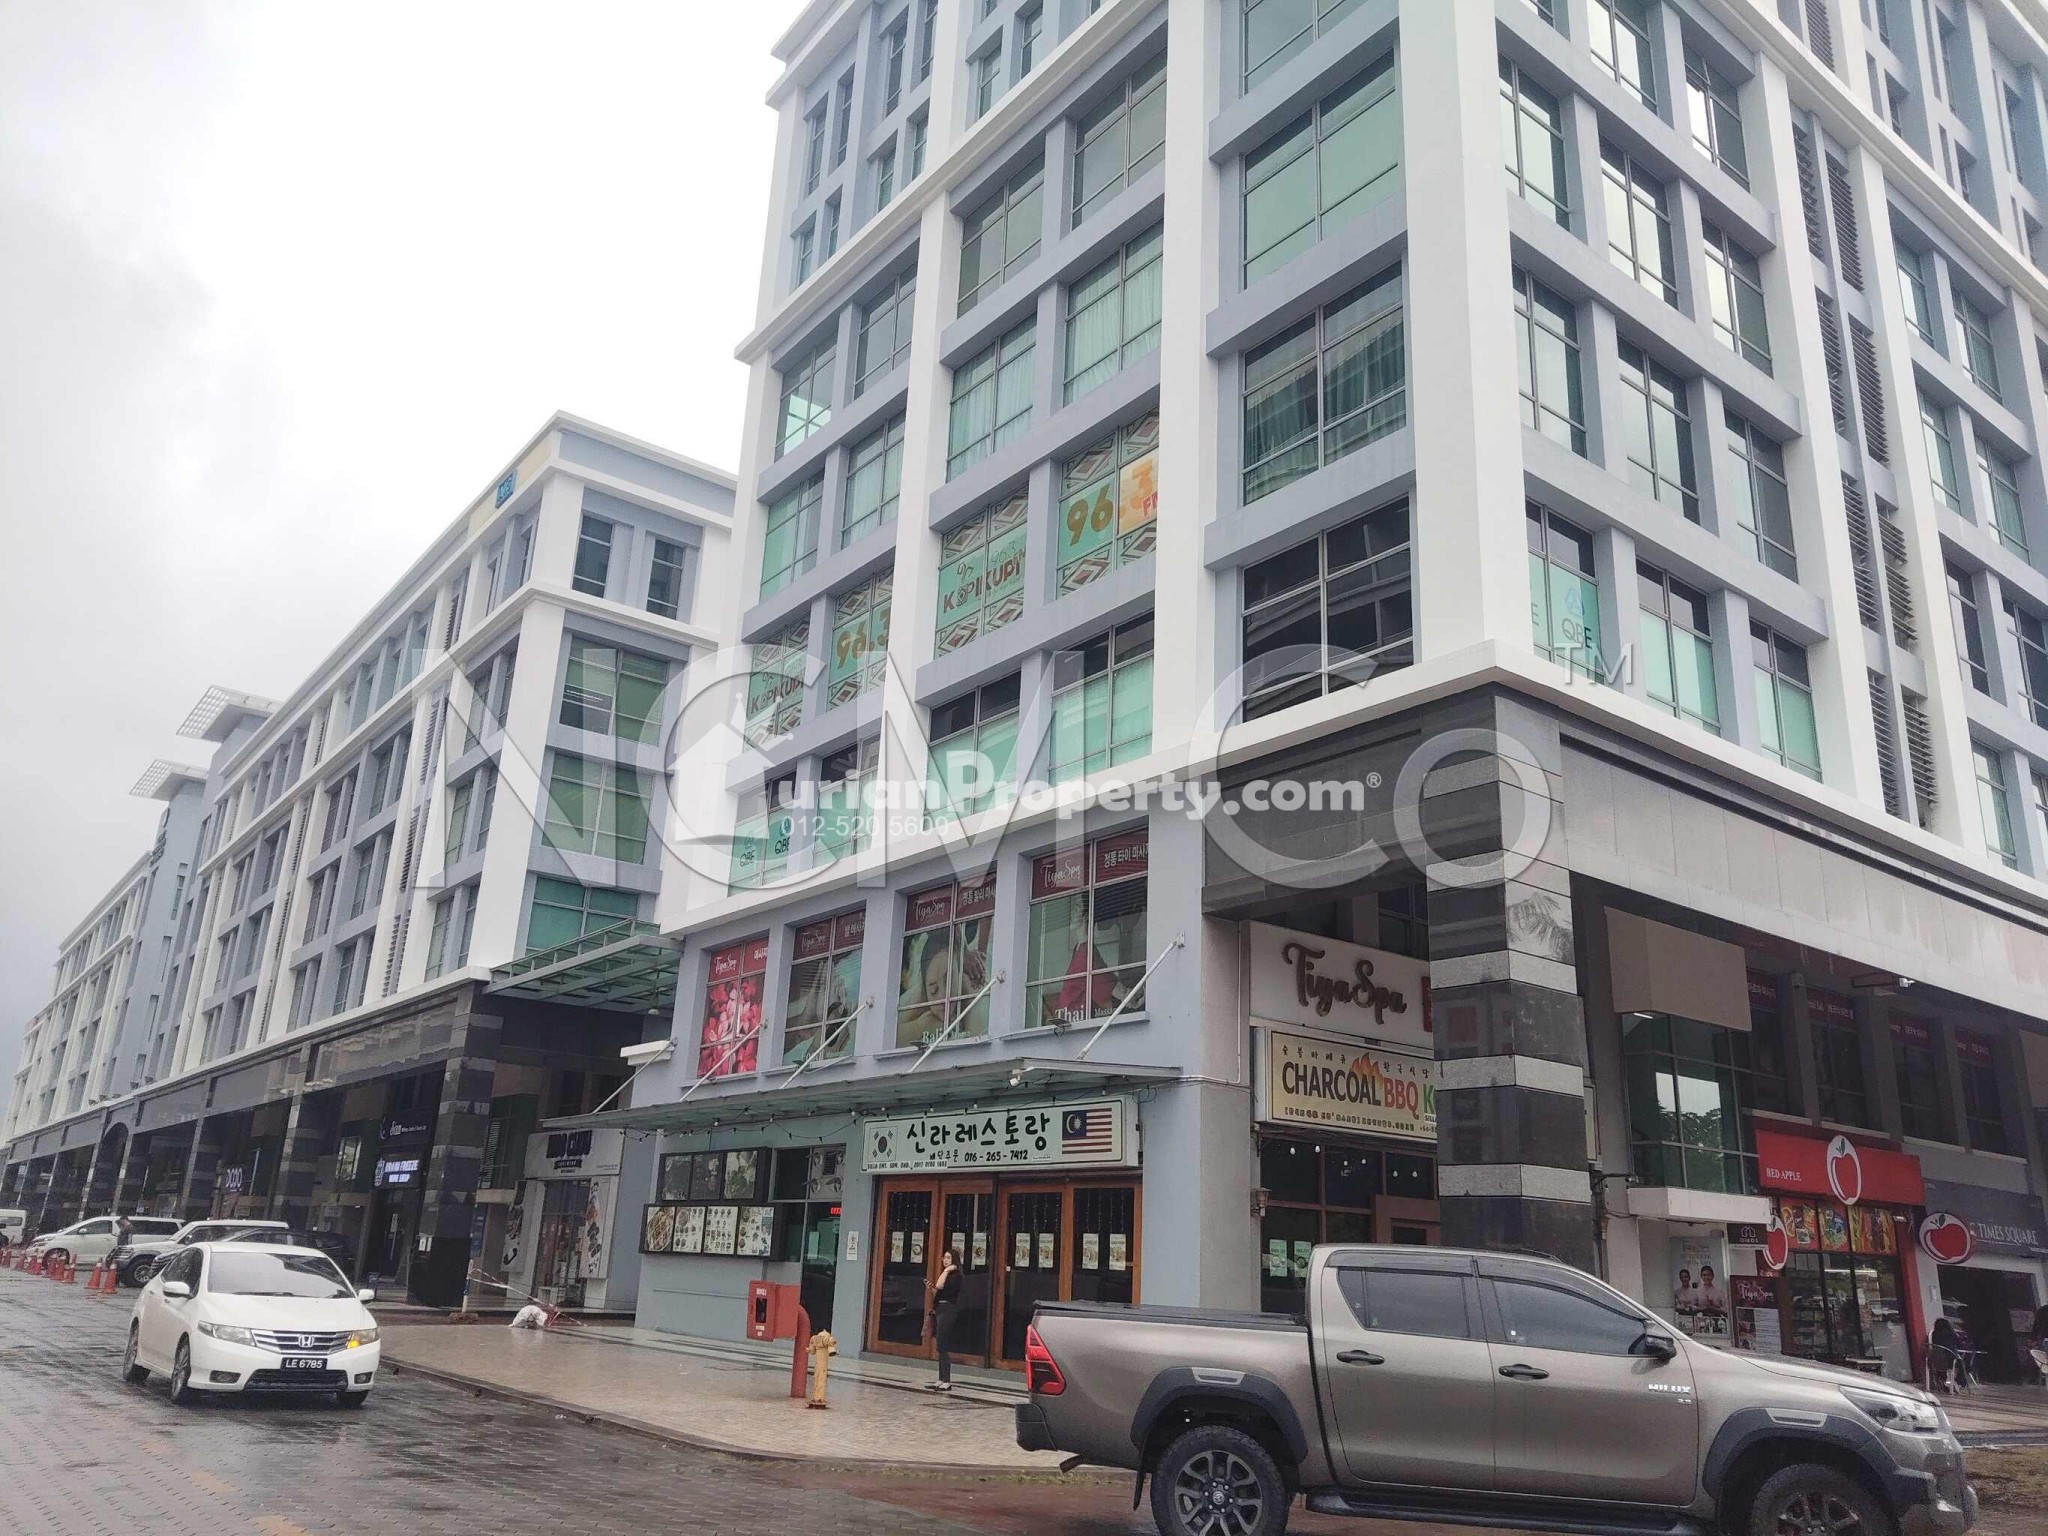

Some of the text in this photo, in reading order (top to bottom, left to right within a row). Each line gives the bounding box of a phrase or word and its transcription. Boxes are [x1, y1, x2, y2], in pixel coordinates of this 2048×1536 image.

[1561, 617, 1592, 650] QBE
[1055, 1004, 1085, 1022] Thai
[1282, 1061, 1382, 1106] CHARCOAL
[1383, 1077, 1420, 1120] BBQ
[906, 1111, 1051, 1154] 신라레스토랑
[1765, 1167, 1802, 1182] RED APPLE
[1976, 1222, 2005, 1241] TIMES
[2004, 1225, 2040, 1247] SQUARE
[285, 1359, 323, 1369] LE 6785
